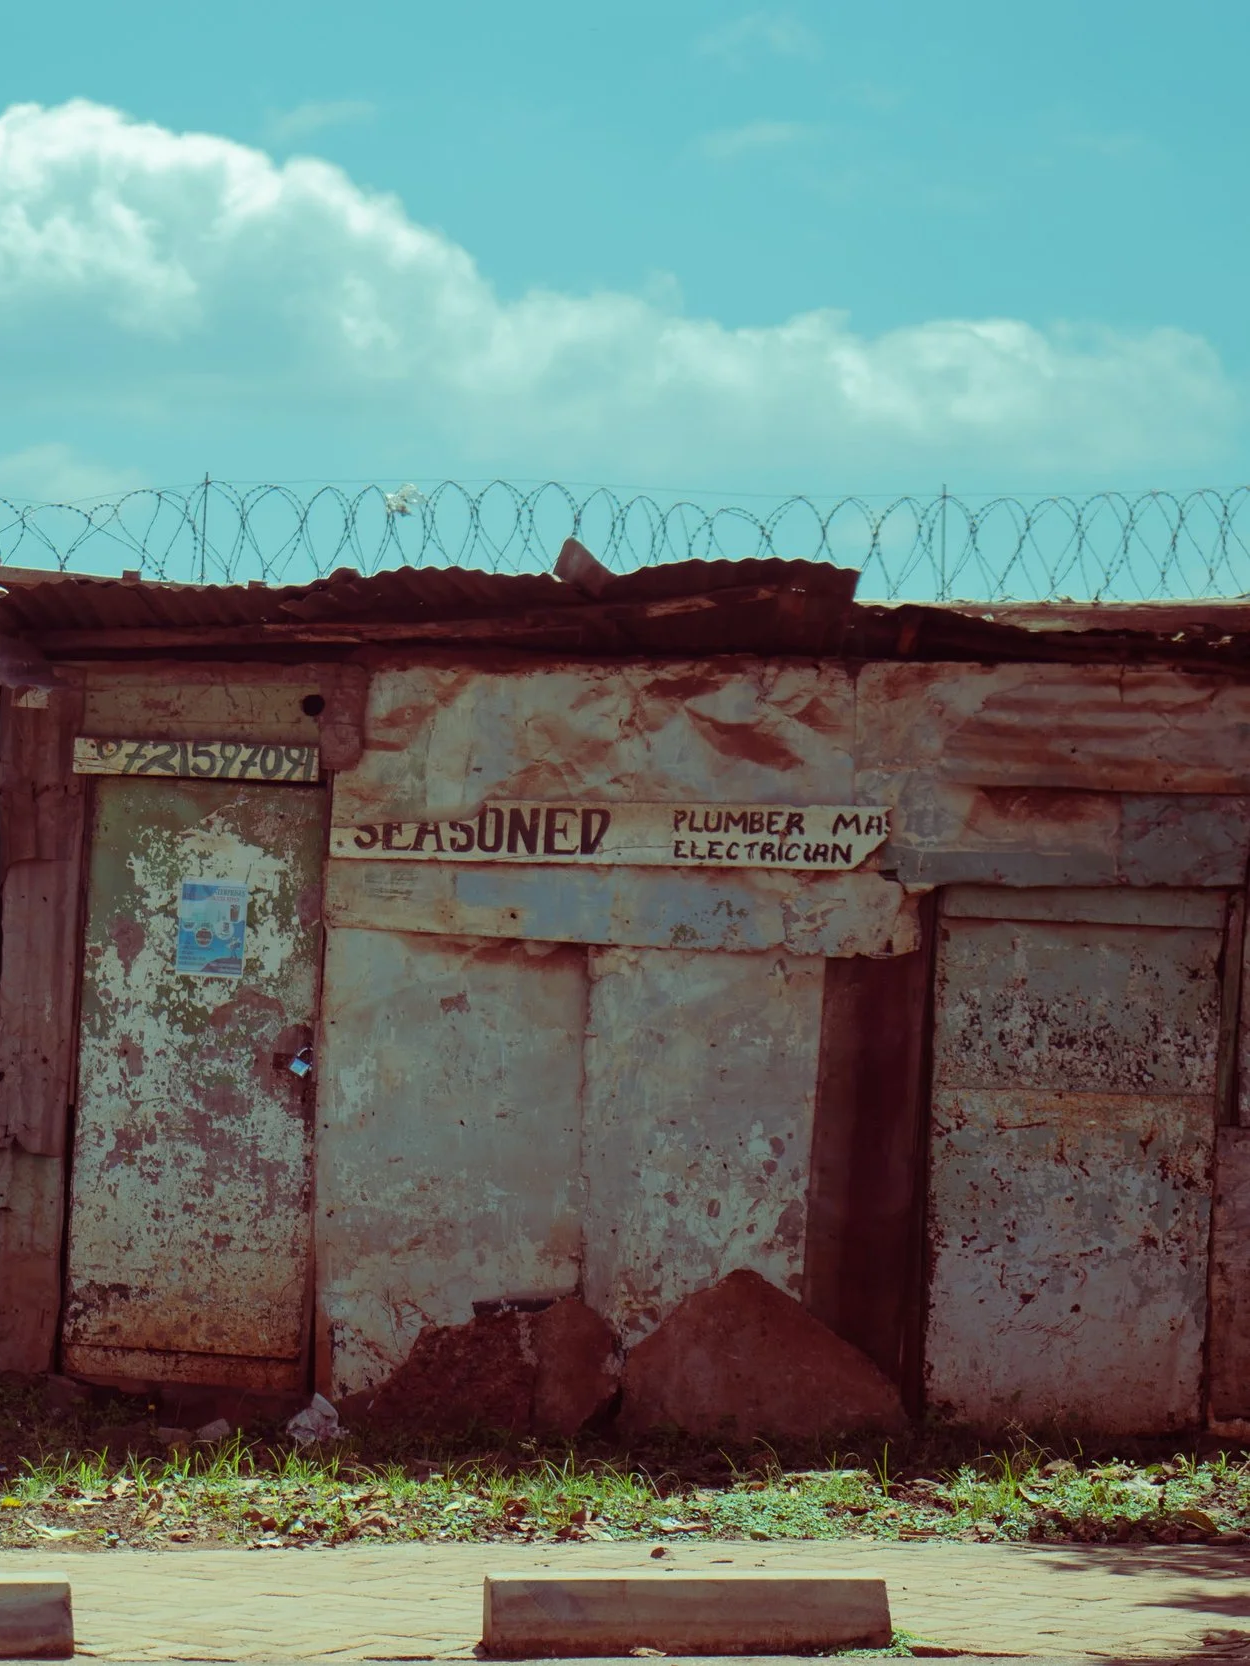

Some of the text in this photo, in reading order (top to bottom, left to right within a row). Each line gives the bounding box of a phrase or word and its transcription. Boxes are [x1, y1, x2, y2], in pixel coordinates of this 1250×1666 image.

[353, 806, 611, 855] SEASONED
[673, 809, 805, 836] PLUMBER
[673, 840, 853, 864] ELECTRICIAN
